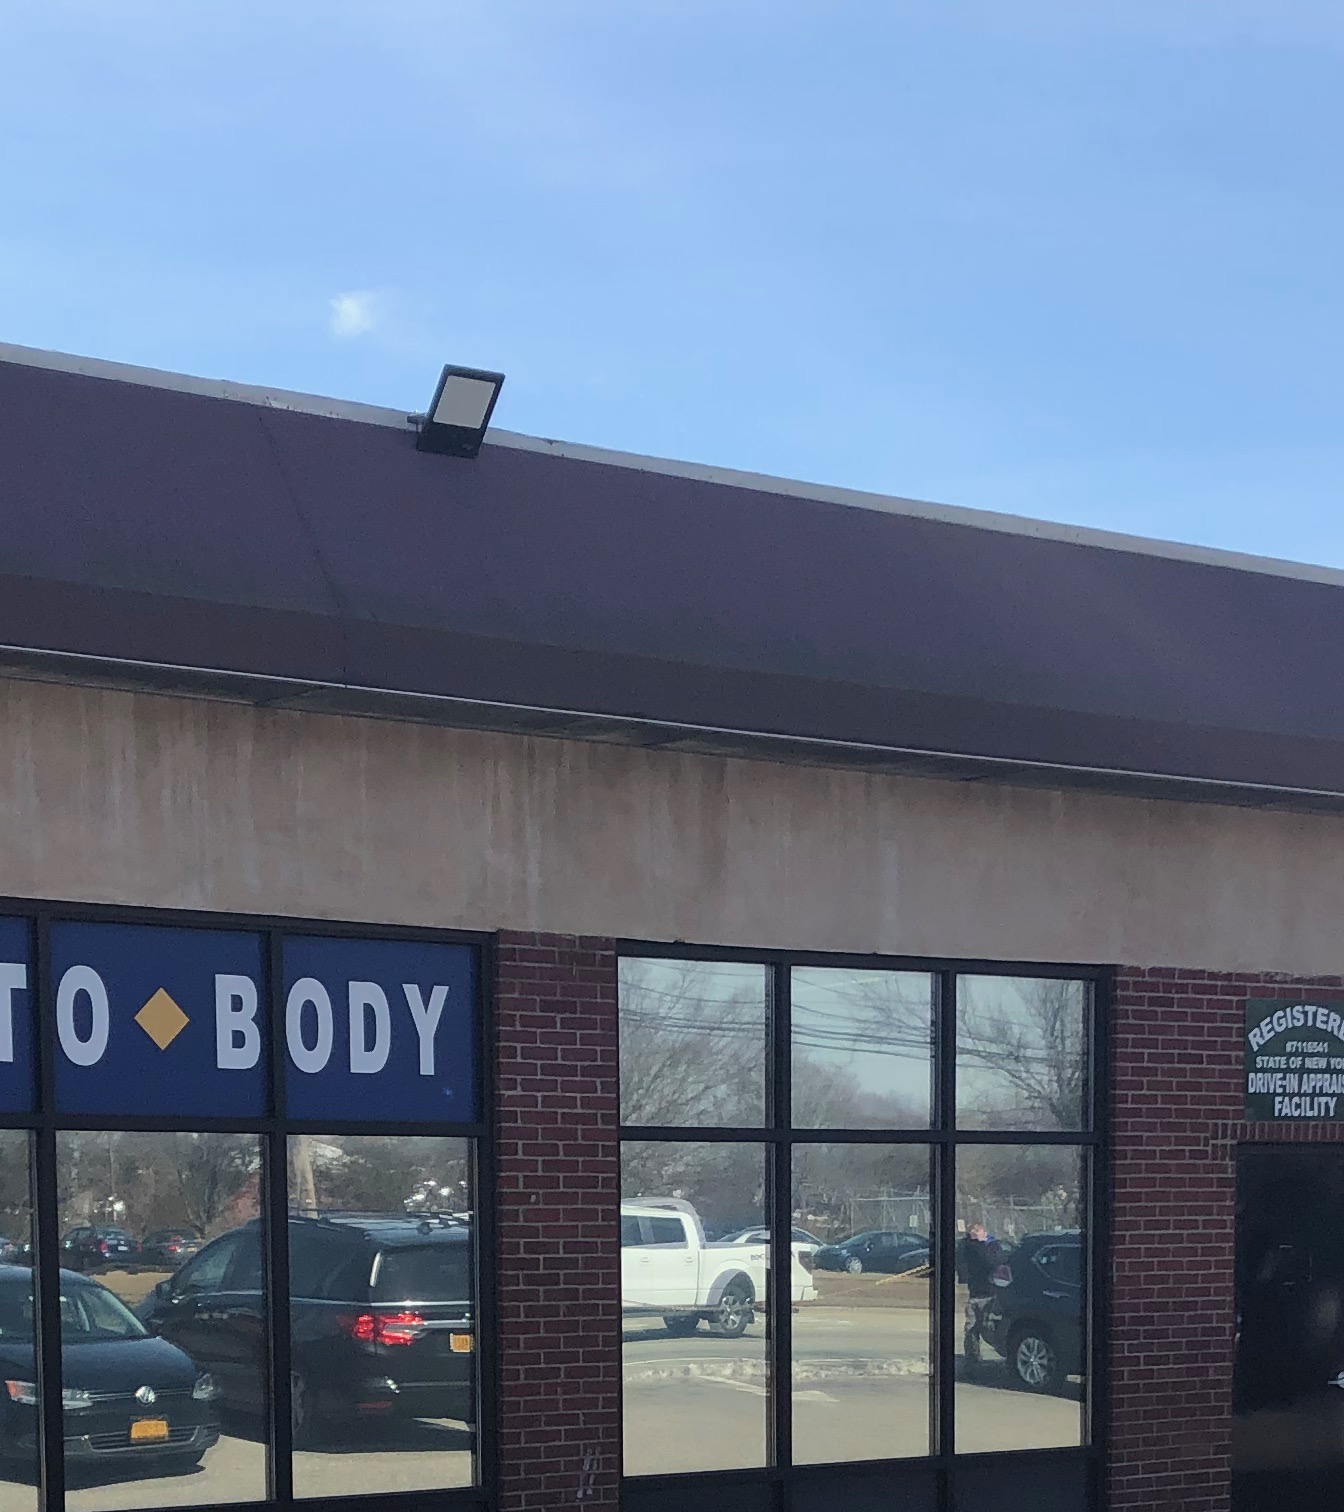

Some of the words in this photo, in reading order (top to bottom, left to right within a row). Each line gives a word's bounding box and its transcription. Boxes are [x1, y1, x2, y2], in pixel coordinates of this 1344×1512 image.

[214, 973, 450, 1077] BODY
[1256, 1056, 1288, 1069] STATE
[1289, 1056, 1303, 1069] OF
[1304, 1057, 1328, 1069] NEW
[1248, 1072, 1299, 1094] DRIVE-IN
[1274, 1096, 1337, 1117] FACILITY
